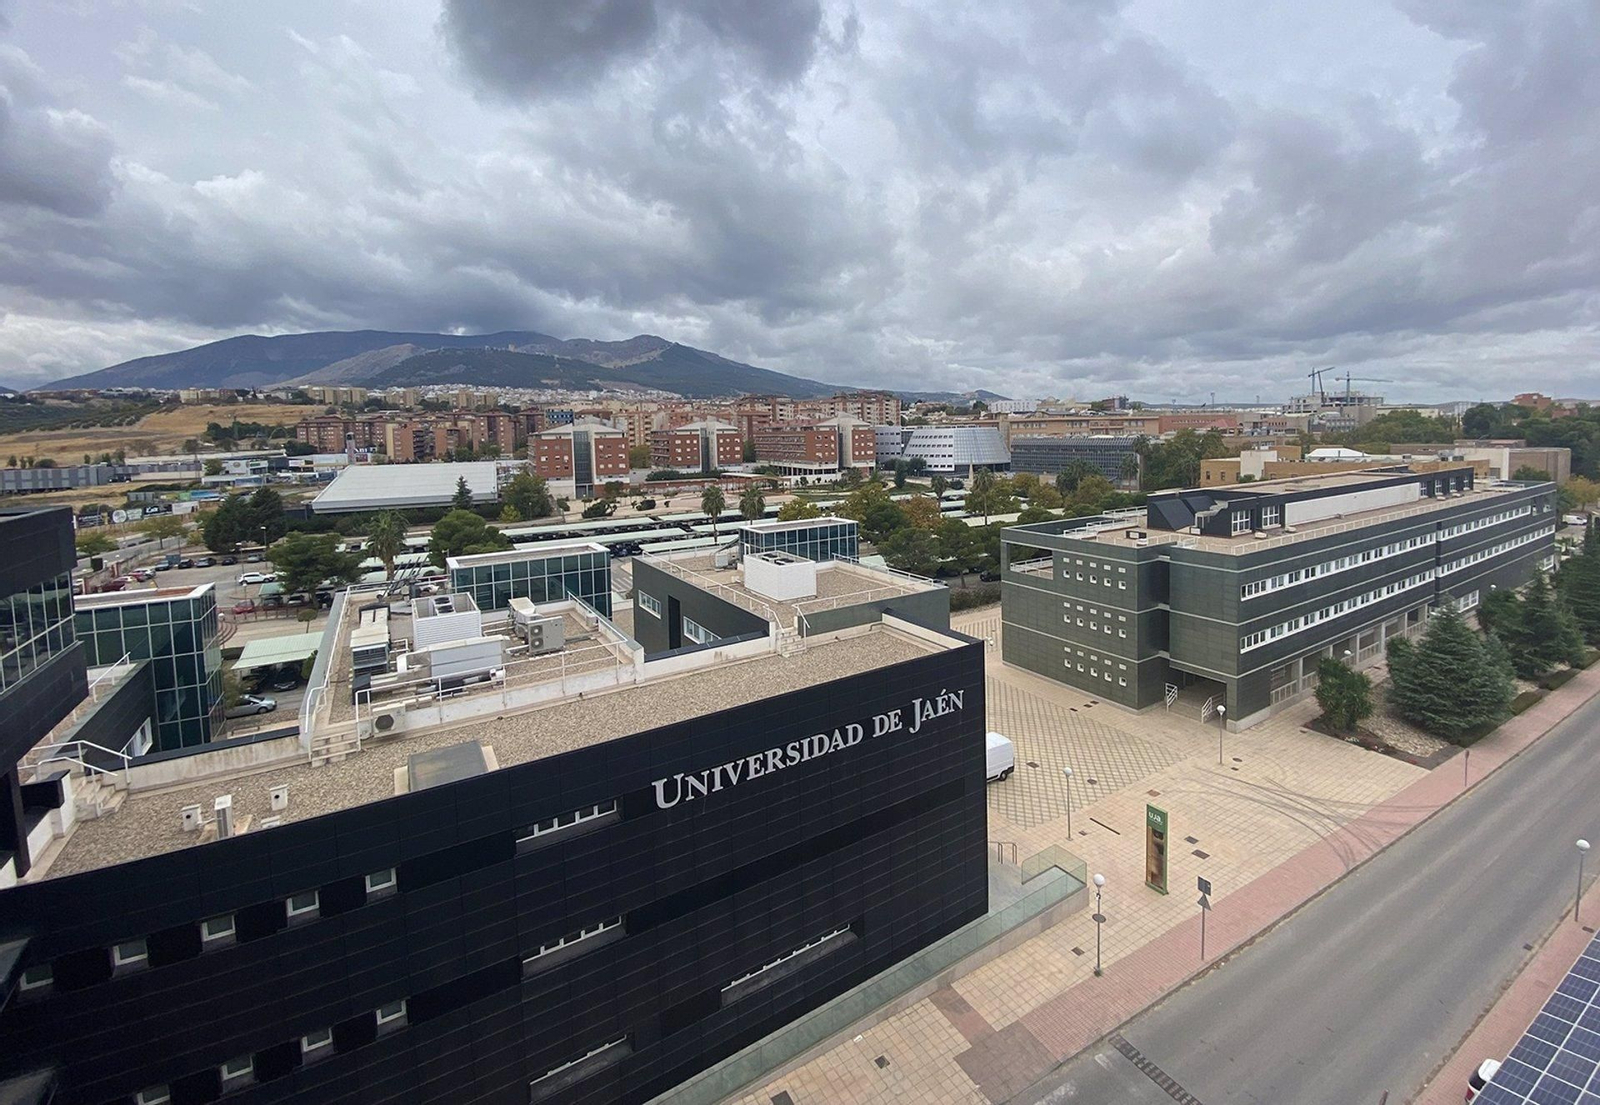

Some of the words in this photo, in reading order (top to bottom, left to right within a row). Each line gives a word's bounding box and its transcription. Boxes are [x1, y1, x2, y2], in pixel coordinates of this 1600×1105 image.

[651, 723, 863, 809] UNIVERSIDAD
[872, 709, 903, 738] DE
[909, 688, 965, 734] JAÉN
